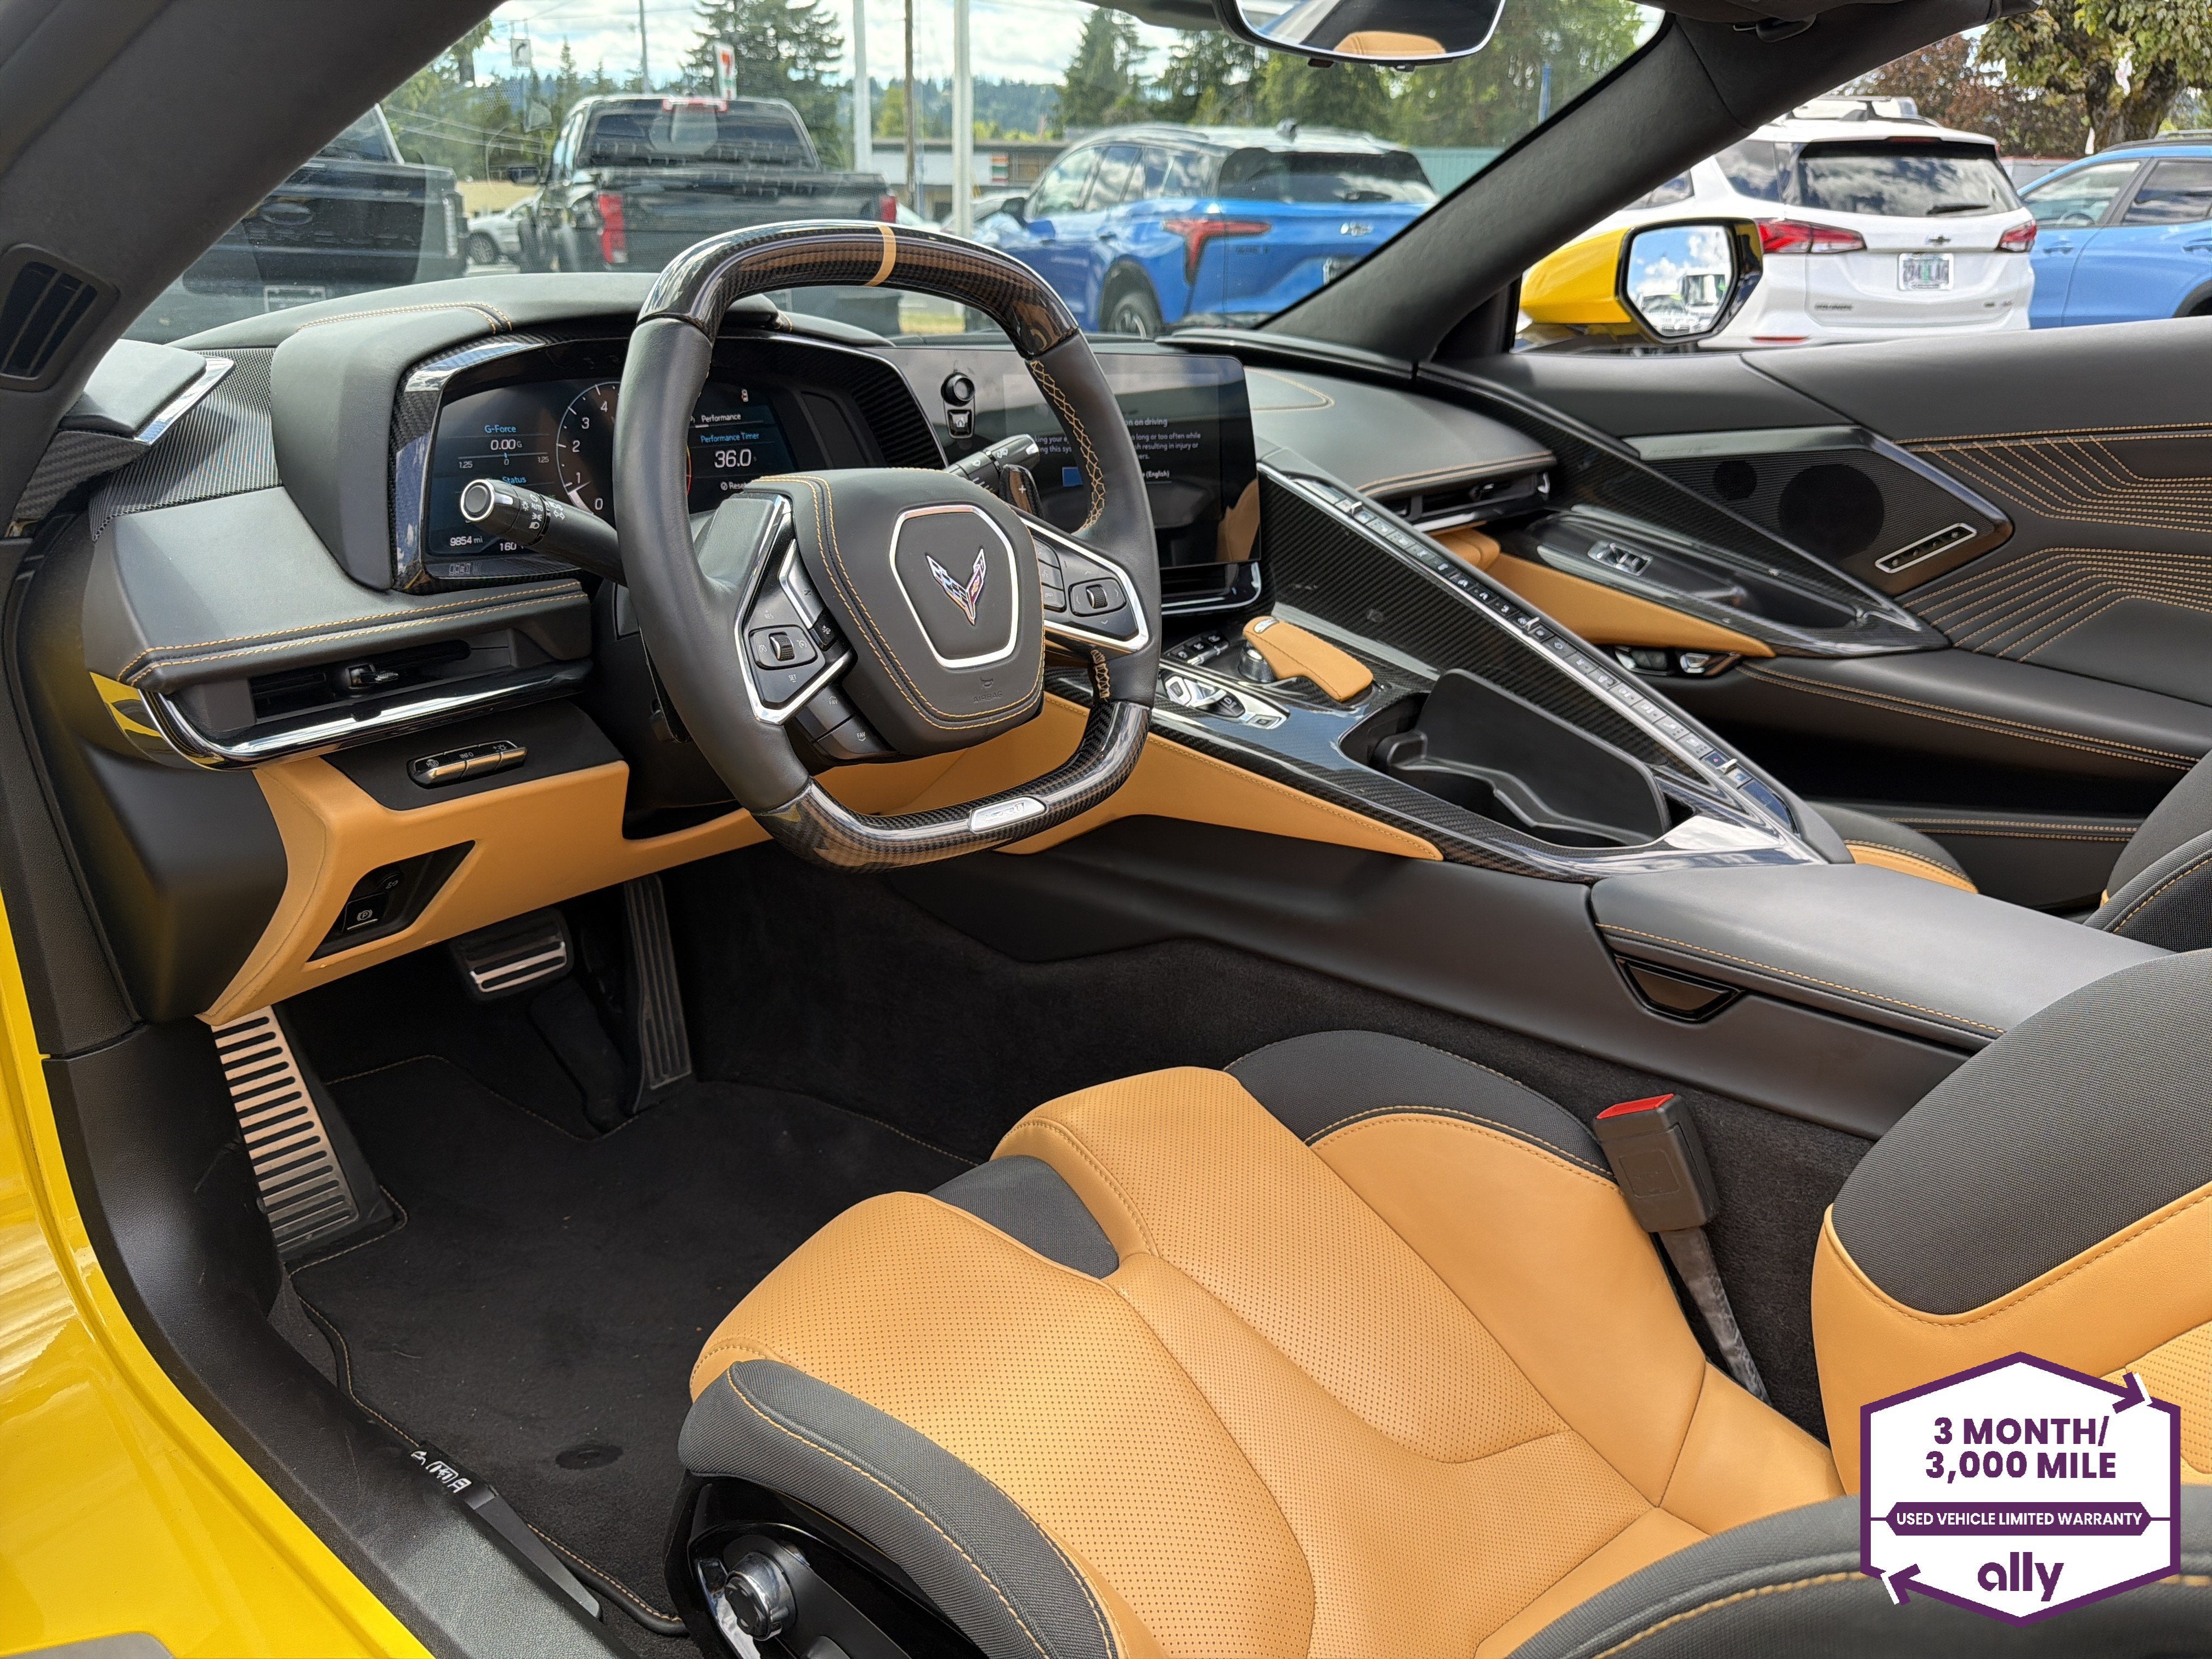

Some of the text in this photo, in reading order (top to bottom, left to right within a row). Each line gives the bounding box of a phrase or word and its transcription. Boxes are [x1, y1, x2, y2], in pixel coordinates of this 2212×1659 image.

[600, 400, 608, 413] 4
[581, 416, 590, 430] 3
[701, 413, 741, 423] Performance
[1144, 417, 1167, 427] driving
[484, 424, 517, 433] G-Force
[700, 431, 759, 443] Performance Timer
[1136, 433, 1149, 442] long
[490, 439, 516, 450] 0.00
[572, 440, 580, 453] 2
[1142, 442, 1167, 451] resulting
[1175, 442, 1192, 450] injury
[714, 448, 752, 469] 36.0
[576, 472, 580, 484] 1
[1146, 470, 1170, 478] (English)
[531, 503, 544, 512] AUTO
[595, 498, 603, 510] 0
[450, 536, 483, 546] 9854 mi
[499, 542, 517, 551] 160
[974, 690, 1002, 703] AIRBAG
